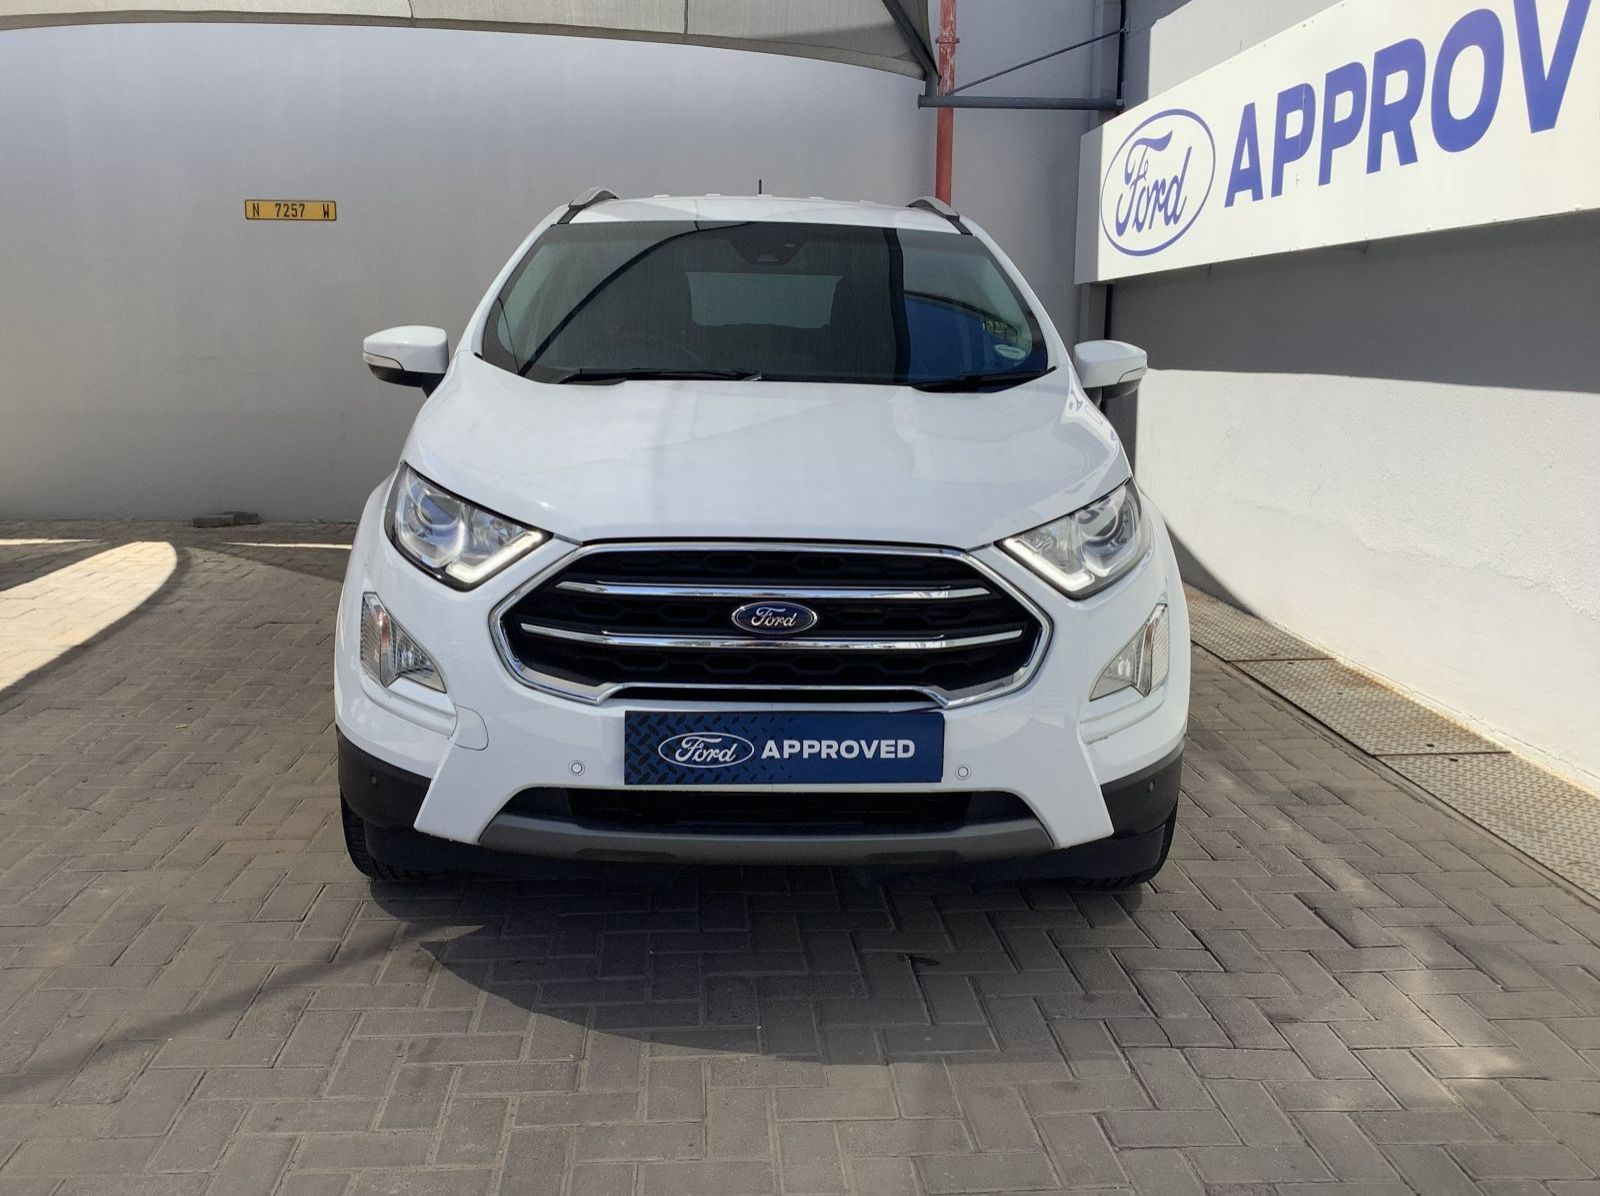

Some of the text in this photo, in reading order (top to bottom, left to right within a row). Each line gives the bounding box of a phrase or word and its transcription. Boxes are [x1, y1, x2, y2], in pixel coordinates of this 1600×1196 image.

[1115, 0, 1592, 237] Ford APPROV
[252, 202, 260, 217] N
[274, 203, 306, 218] 7257
[751, 606, 798, 627] Ford
[674, 736, 916, 764] Ford APPROVED
